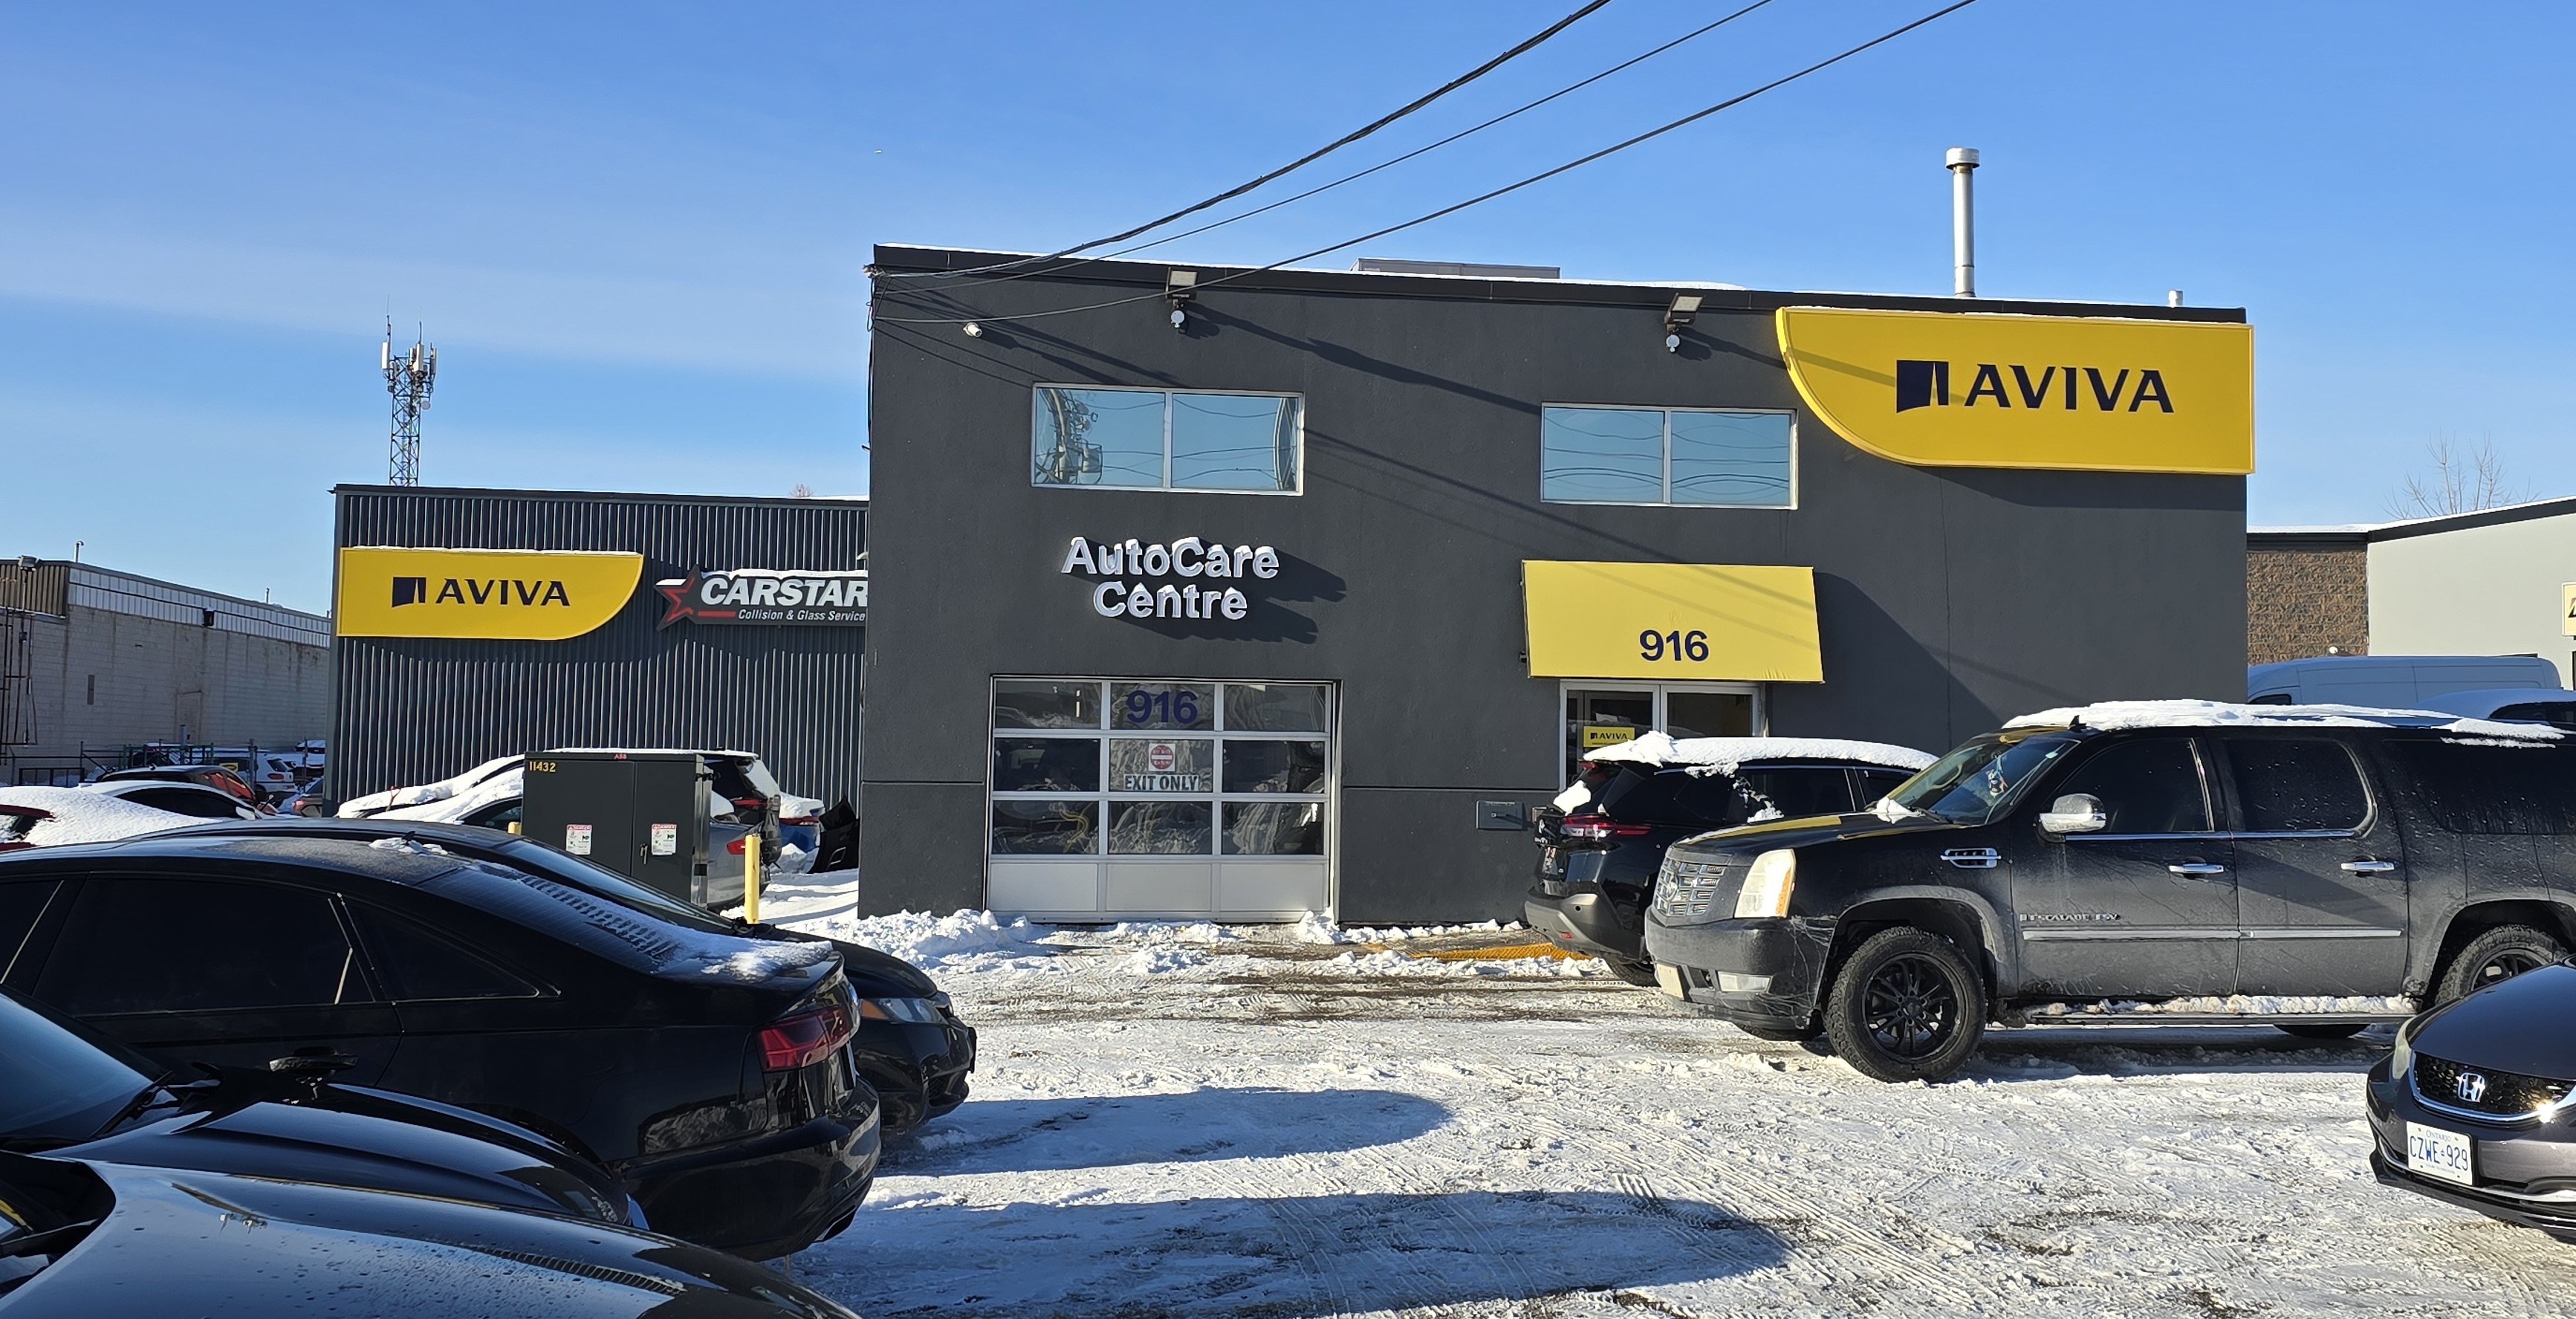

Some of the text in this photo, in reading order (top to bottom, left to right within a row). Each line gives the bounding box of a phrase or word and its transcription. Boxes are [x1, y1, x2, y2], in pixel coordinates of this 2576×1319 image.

[1964, 363, 2174, 413] AVIVA
[1060, 537, 1279, 579] AutoCare
[435, 578, 571, 606] AVIVA
[701, 577, 869, 607] CARSTAR
[1093, 581, 1248, 620] Centre
[738, 609, 783, 621] Collision
[786, 610, 794, 620] &
[797, 610, 825, 621] Glass
[1640, 629, 1709, 661] 916
[1126, 690, 1198, 724] 916
[529, 761, 556, 772] 11432
[1124, 775, 1198, 791] EXIT ONLY
